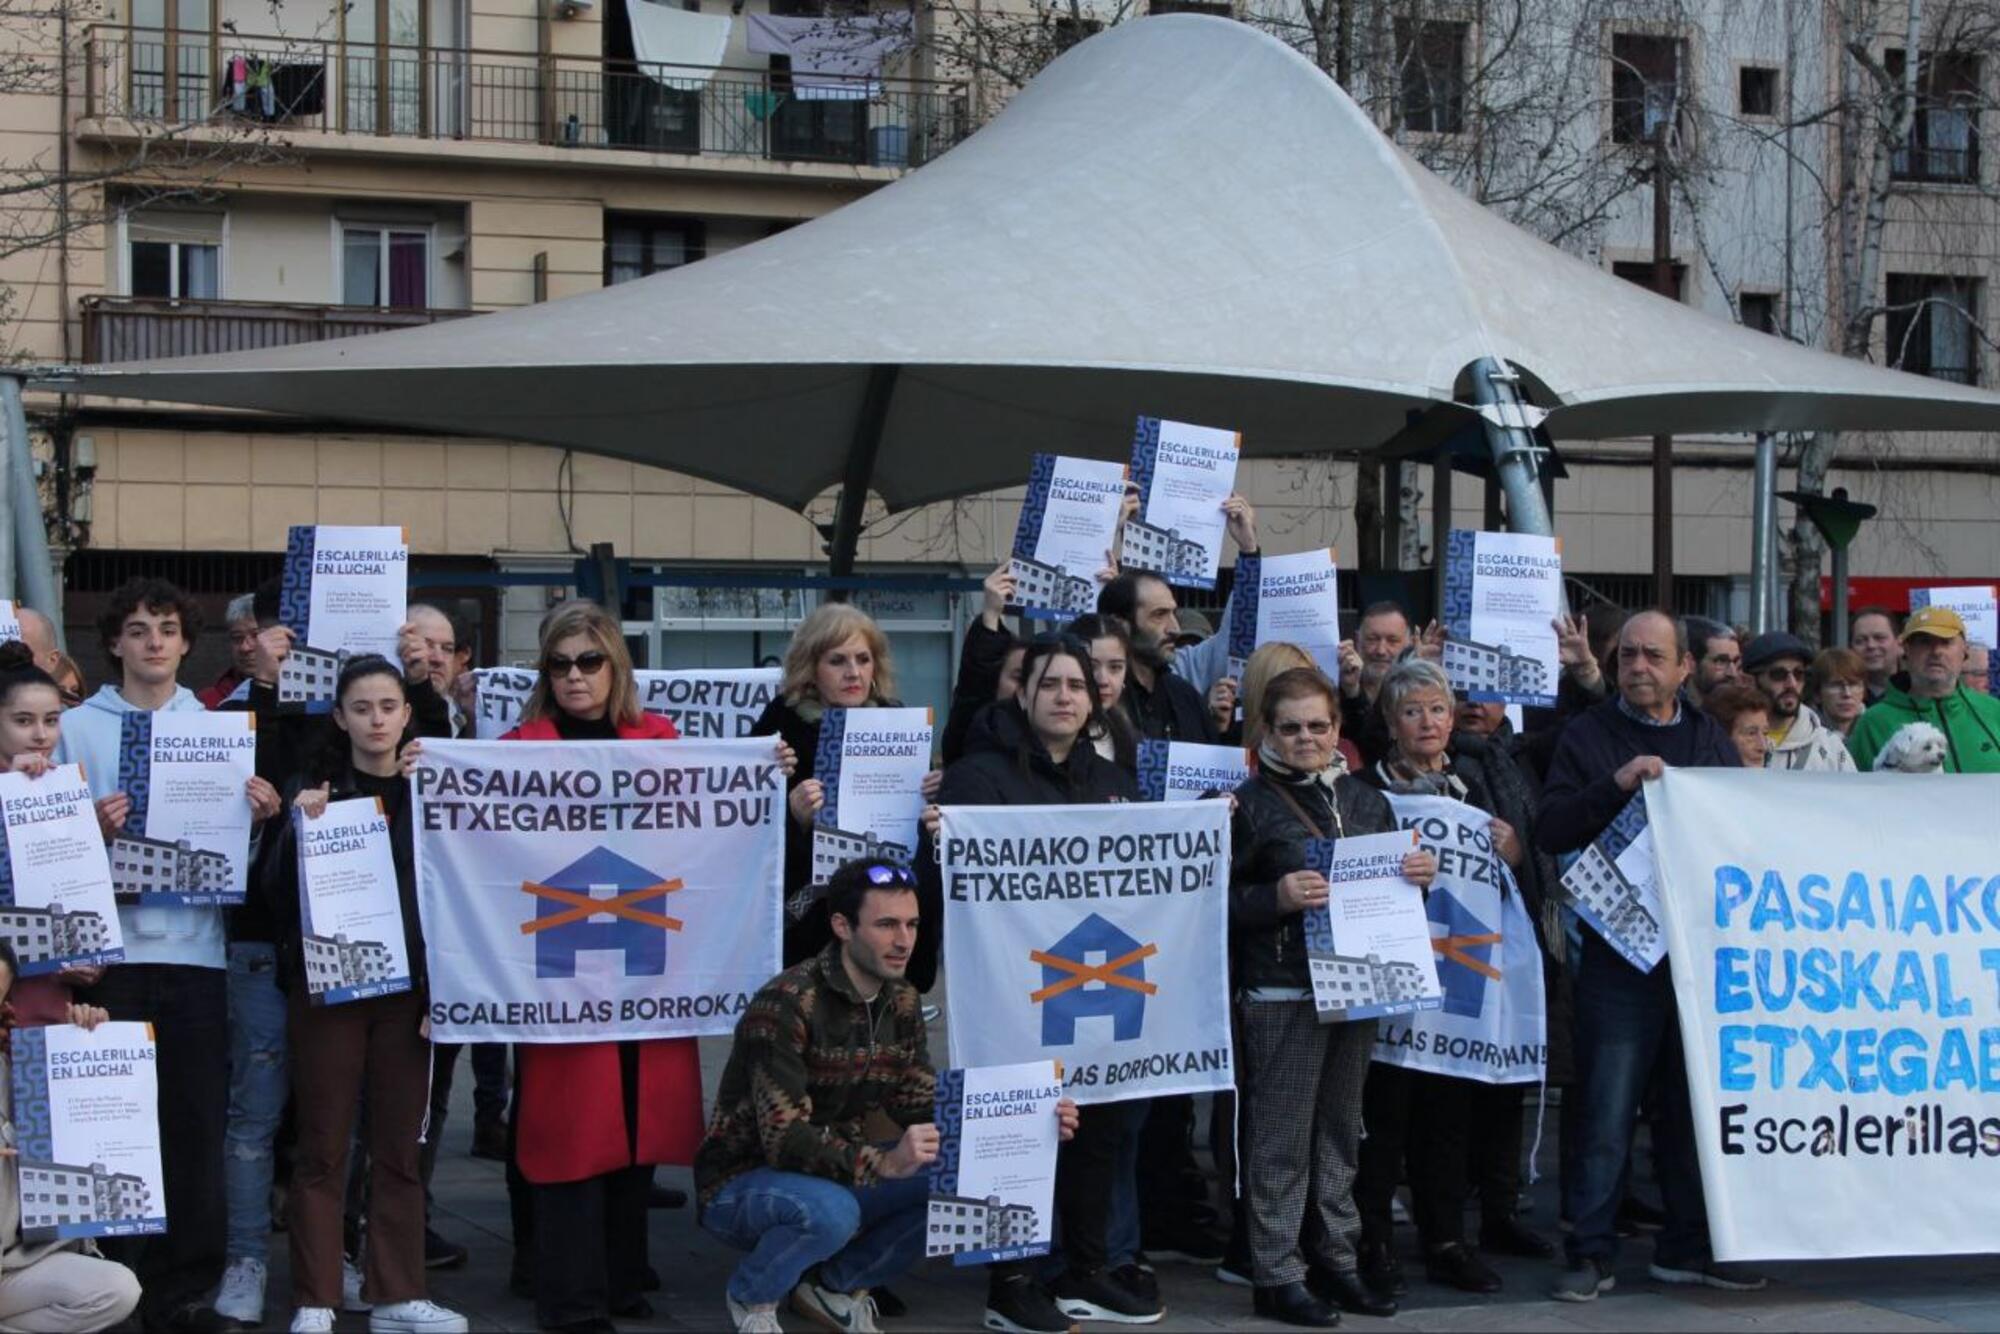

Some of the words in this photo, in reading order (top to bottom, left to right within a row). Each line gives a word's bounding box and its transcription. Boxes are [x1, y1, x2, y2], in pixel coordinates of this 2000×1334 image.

[1160, 441, 1236, 462] ESCALERILLAS
[1158, 453, 1174, 464] EN
[1175, 455, 1217, 471] LUCHA!
[1053, 477, 1124, 495] ESCALERILLAS
[1050, 489, 1065, 500] EN
[1067, 492, 1105, 504] LUCHA!
[316, 550, 407, 561] ESCALERILLAS
[1476, 553, 1561, 569] ESCALERILLAS
[316, 563, 333, 575] EN
[338, 563, 387, 575] LUCHA!
[1262, 569, 1336, 587] ESCALERILLAS
[1476, 565, 1549, 580] BORROKAN!
[1262, 583, 1327, 598] BORROKAN!
[154, 737, 256, 749] ESCALERILLAS
[846, 731, 931, 744] ESCALERILLAS
[154, 751, 172, 763] EN
[177, 751, 230, 763] LUCHA!
[845, 744, 918, 757] BORROKAN!
[416, 767, 601, 798] PASAIAKO
[612, 764, 778, 797] PORTUAK
[6, 788, 91, 812] ESCALERILLAS
[8, 812, 28, 827] EN
[32, 804, 79, 824] LUCHA!
[424, 801, 701, 832] ETXEGABETZEN
[714, 797, 772, 827] DU!
[313, 837, 367, 856] LUCHA!
[948, 835, 1090, 867] PASAIAKO
[950, 867, 1173, 902] ETXEGABETZEN
[1714, 946, 1973, 1019] EUSKAL
[620, 992, 757, 1021] BORROKA
[51, 1048, 156, 1065] ESCALERILLAS
[51, 1067, 73, 1080] EN
[77, 1063, 133, 1078] LUCHA!
[1105, 1048, 1229, 1086] BORROKAN!
[966, 1086, 1061, 1105] ESCALERILLAS
[965, 1107, 984, 1120] EN
[986, 1103, 1037, 1118] LUCHA!
